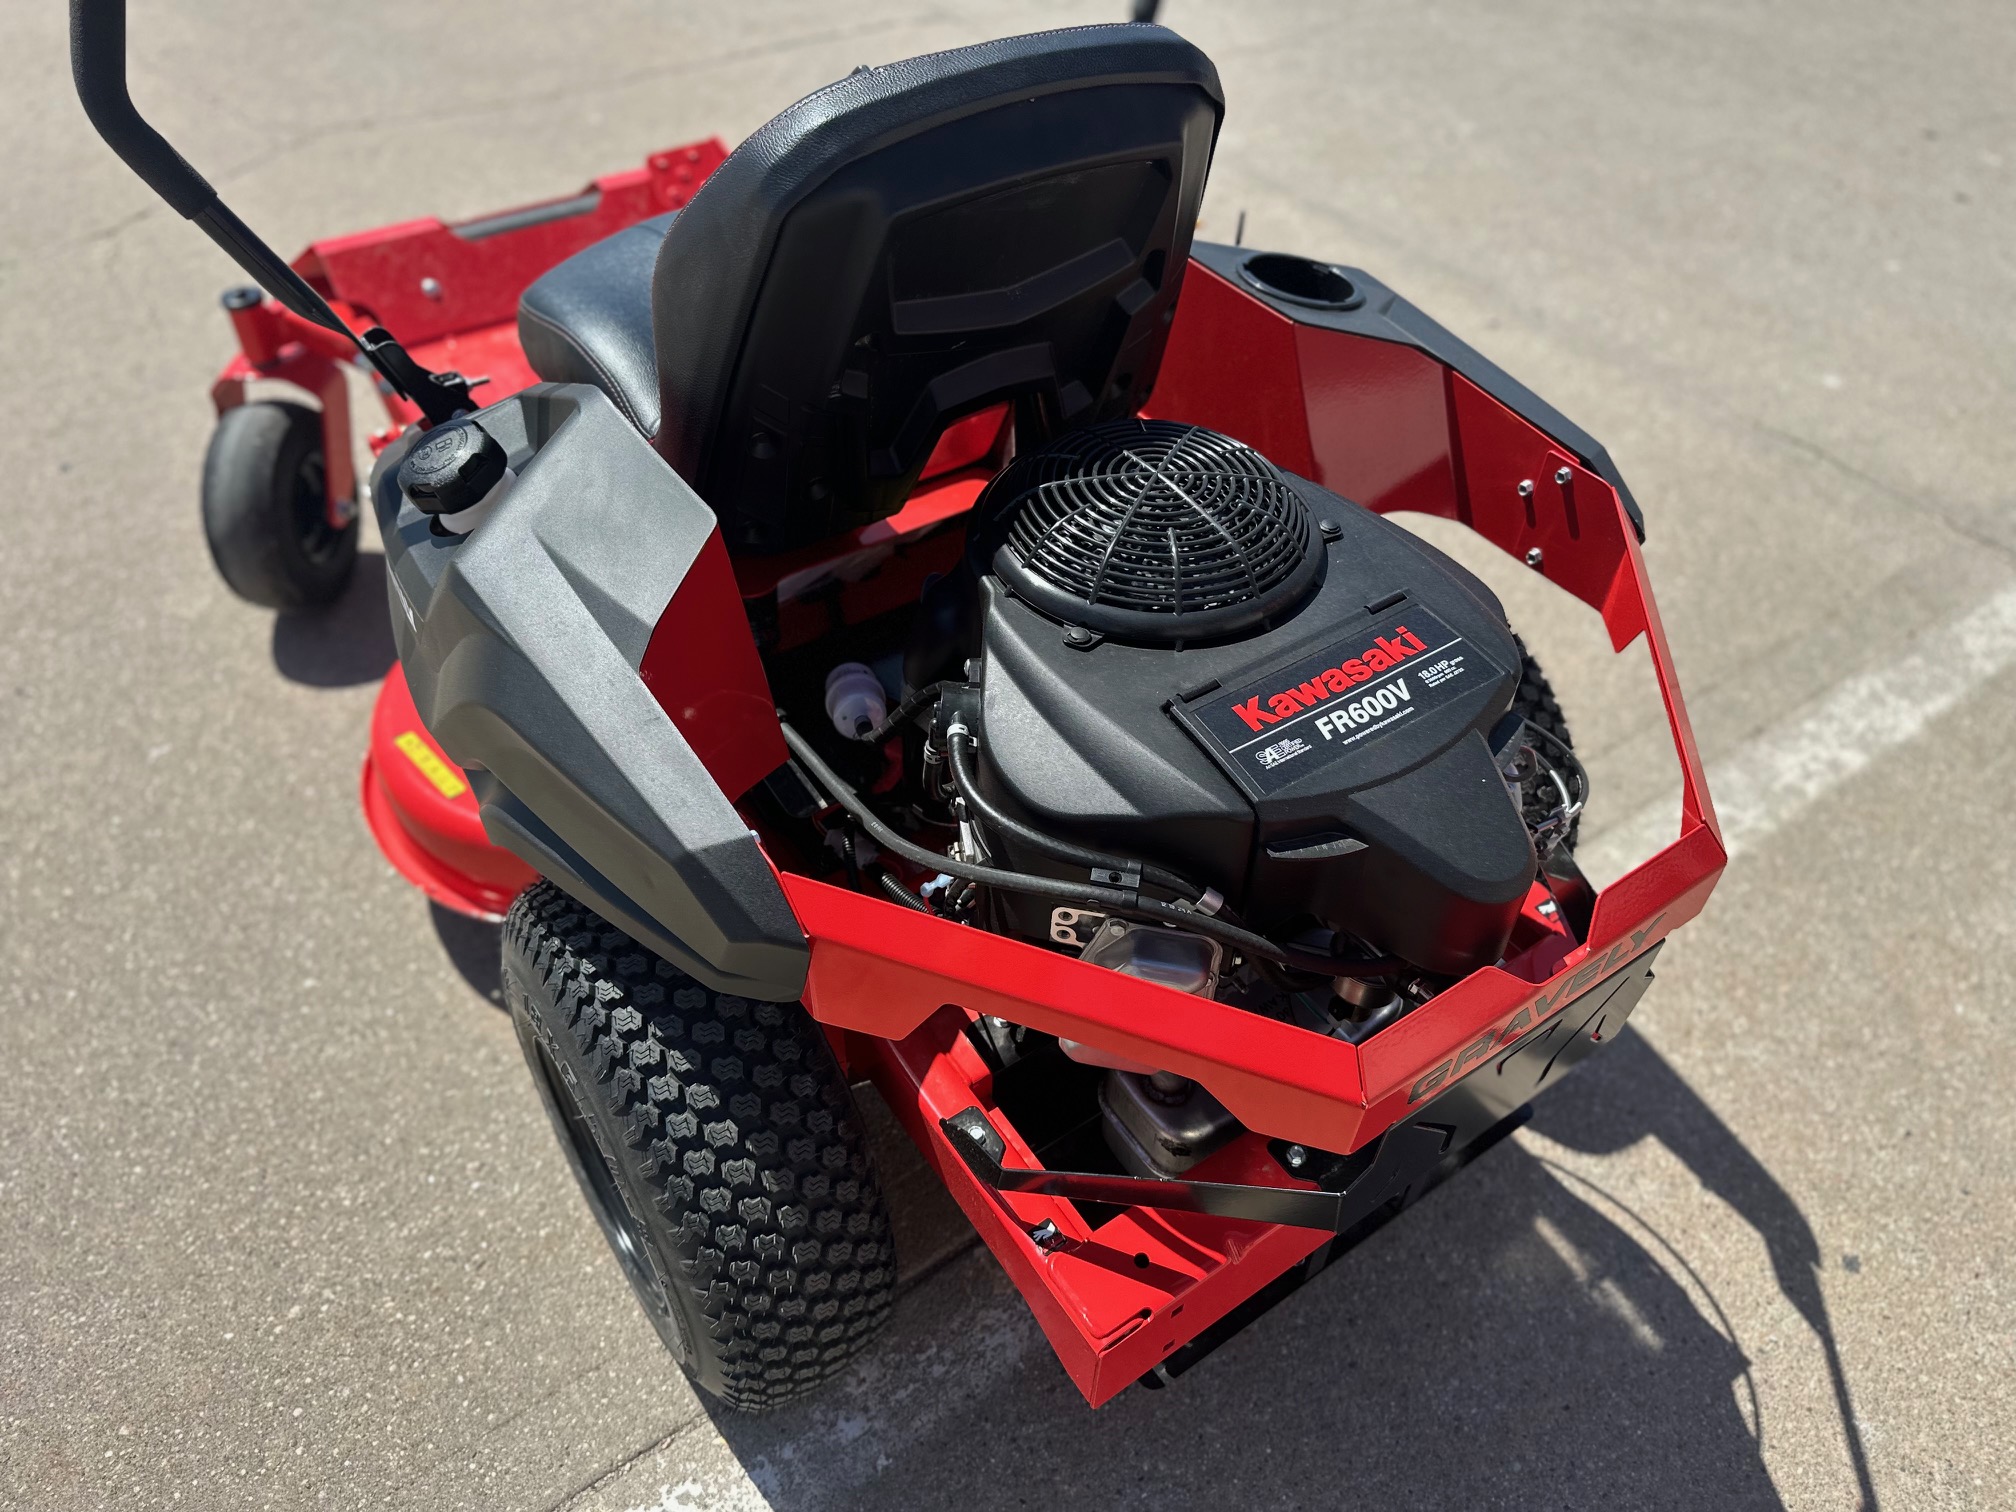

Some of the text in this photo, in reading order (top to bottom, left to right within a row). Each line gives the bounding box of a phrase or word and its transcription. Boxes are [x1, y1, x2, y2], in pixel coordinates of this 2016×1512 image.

[1231, 626, 1428, 732] Kawasaki
[1315, 678, 1411, 740] FR600V
[1255, 743, 1287, 765] SAE
[1342, 707, 1414, 745] www.poweredbykawasaki.com
[1407, 912, 1667, 1104] GRAVELY
